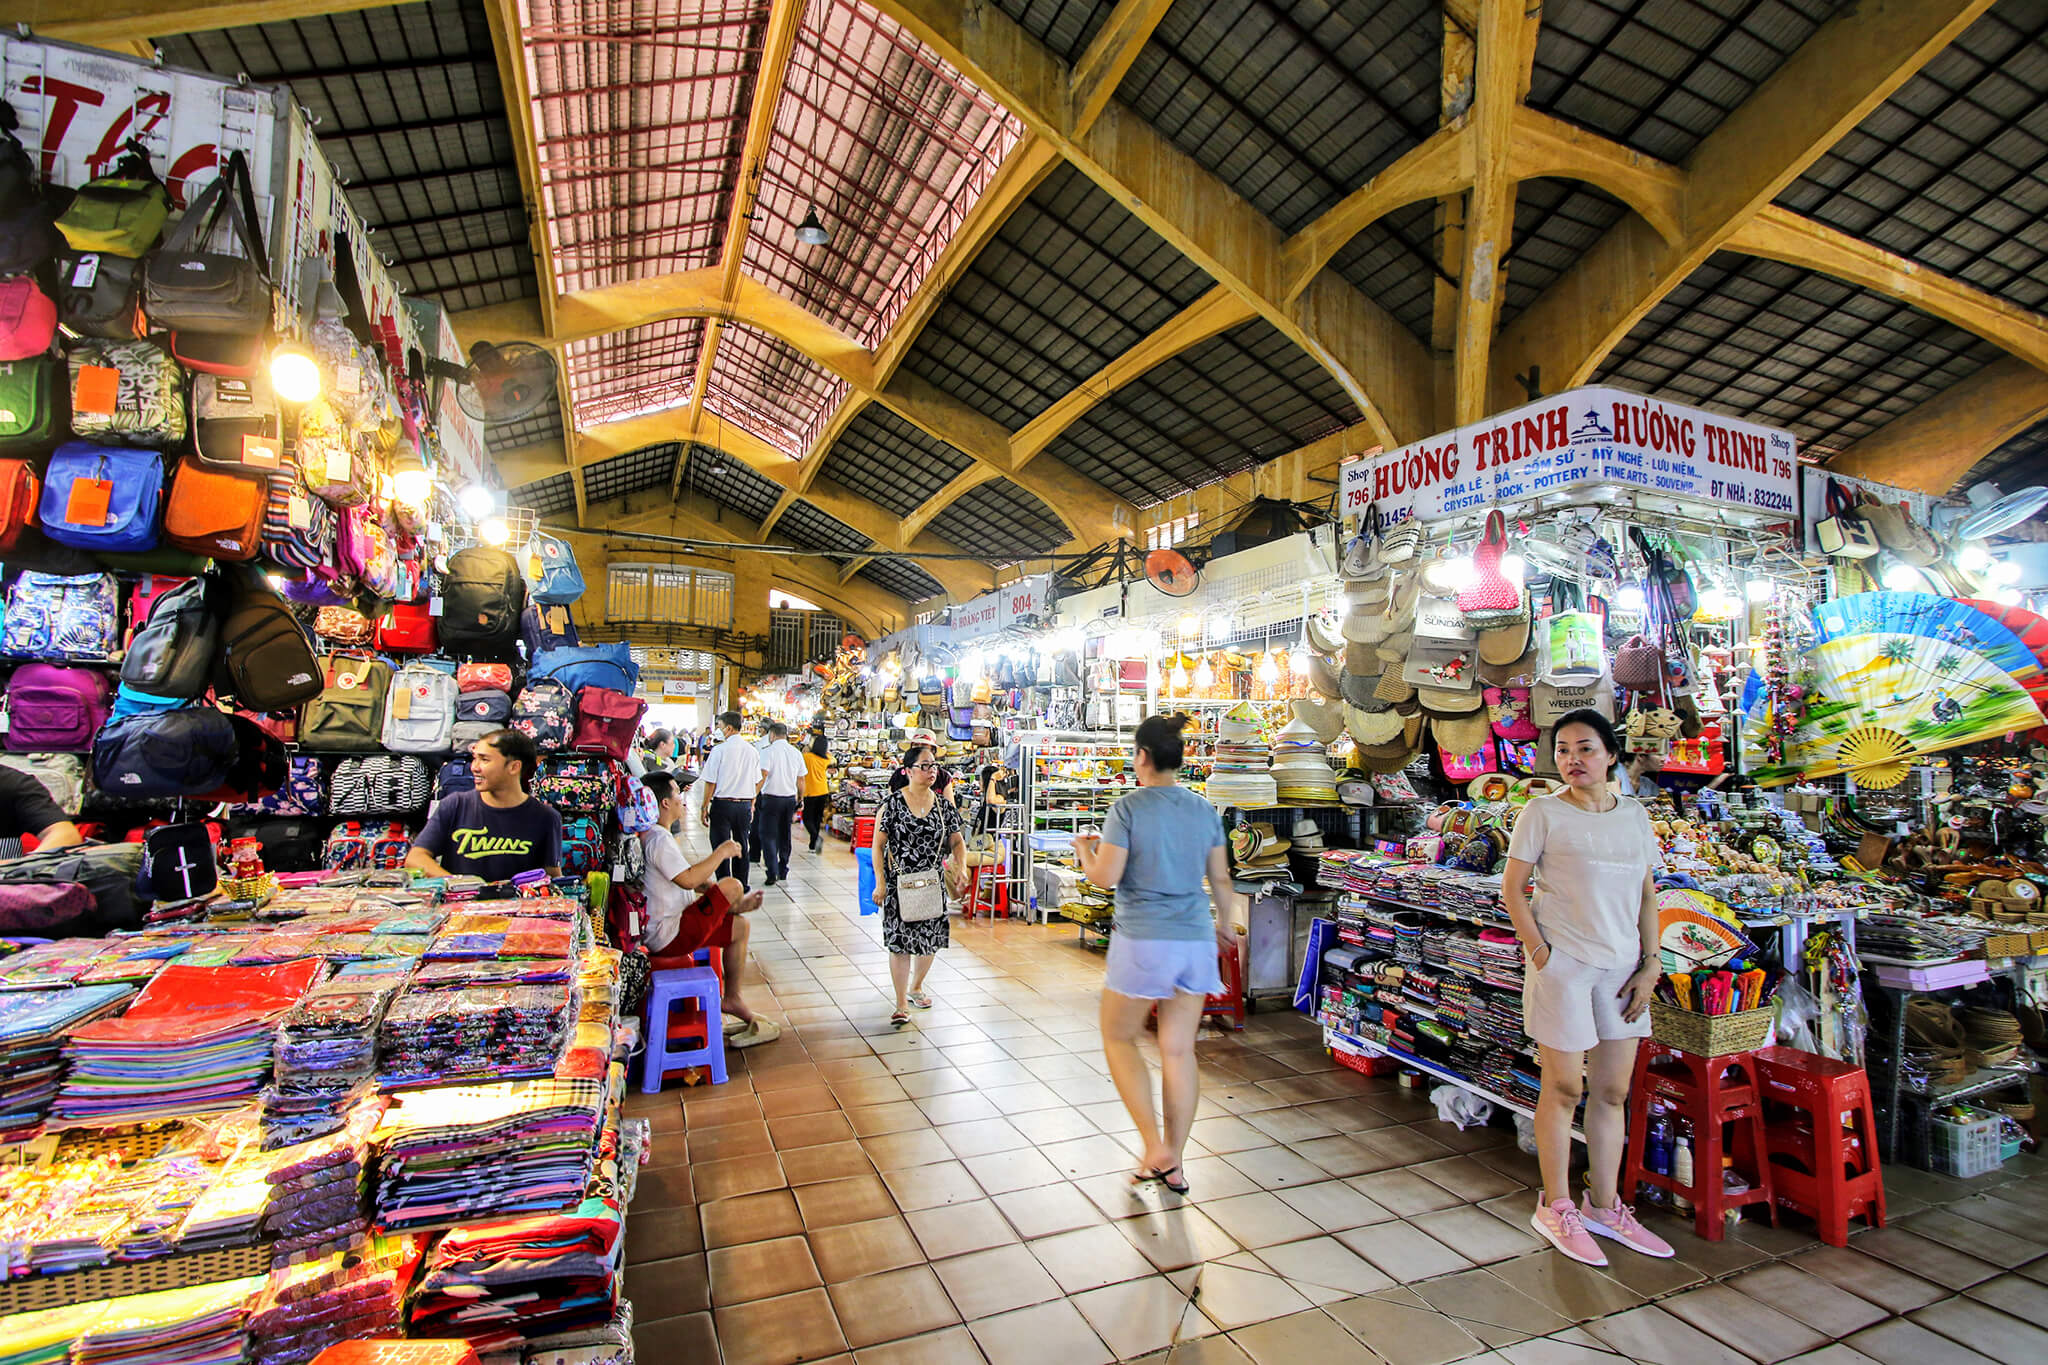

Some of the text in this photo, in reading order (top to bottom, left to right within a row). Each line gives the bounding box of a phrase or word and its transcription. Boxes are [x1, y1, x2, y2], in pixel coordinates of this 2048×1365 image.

[1612, 399, 1767, 474] HƯƠNG TRINH
[1771, 433, 1790, 455] Shop
[1374, 406, 1569, 501] HƯƠNG TRINH
[1347, 468, 1370, 482] Shop
[1444, 484, 1466, 498] PHA
[1469, 476, 1483, 491] LÊ
[1494, 470, 1511, 485] ĐÁ
[1555, 448, 1575, 467] SỨ
[1592, 446, 1613, 460] MỸ
[1618, 451, 1643, 470] NGHỆ
[1772, 458, 1791, 479] 796
[1347, 487, 1369, 508] 796
[1444, 493, 1486, 512] CRYSTAL
[1496, 483, 1524, 499] ROCK
[1534, 466, 1588, 489] POTTERY
[1604, 466, 1625, 479] FINE
[1627, 470, 1648, 485] ARTS
[1711, 480, 1724, 497] ĐT
[1726, 481, 1745, 502] NHÀ
[1753, 488, 1792, 512] 8322244
[1012, 592, 1031, 614] 804
[1424, 617, 1465, 628] SUNDAY
[1556, 687, 1586, 697] HELLO
[1548, 698, 1597, 709] WEEKEND
